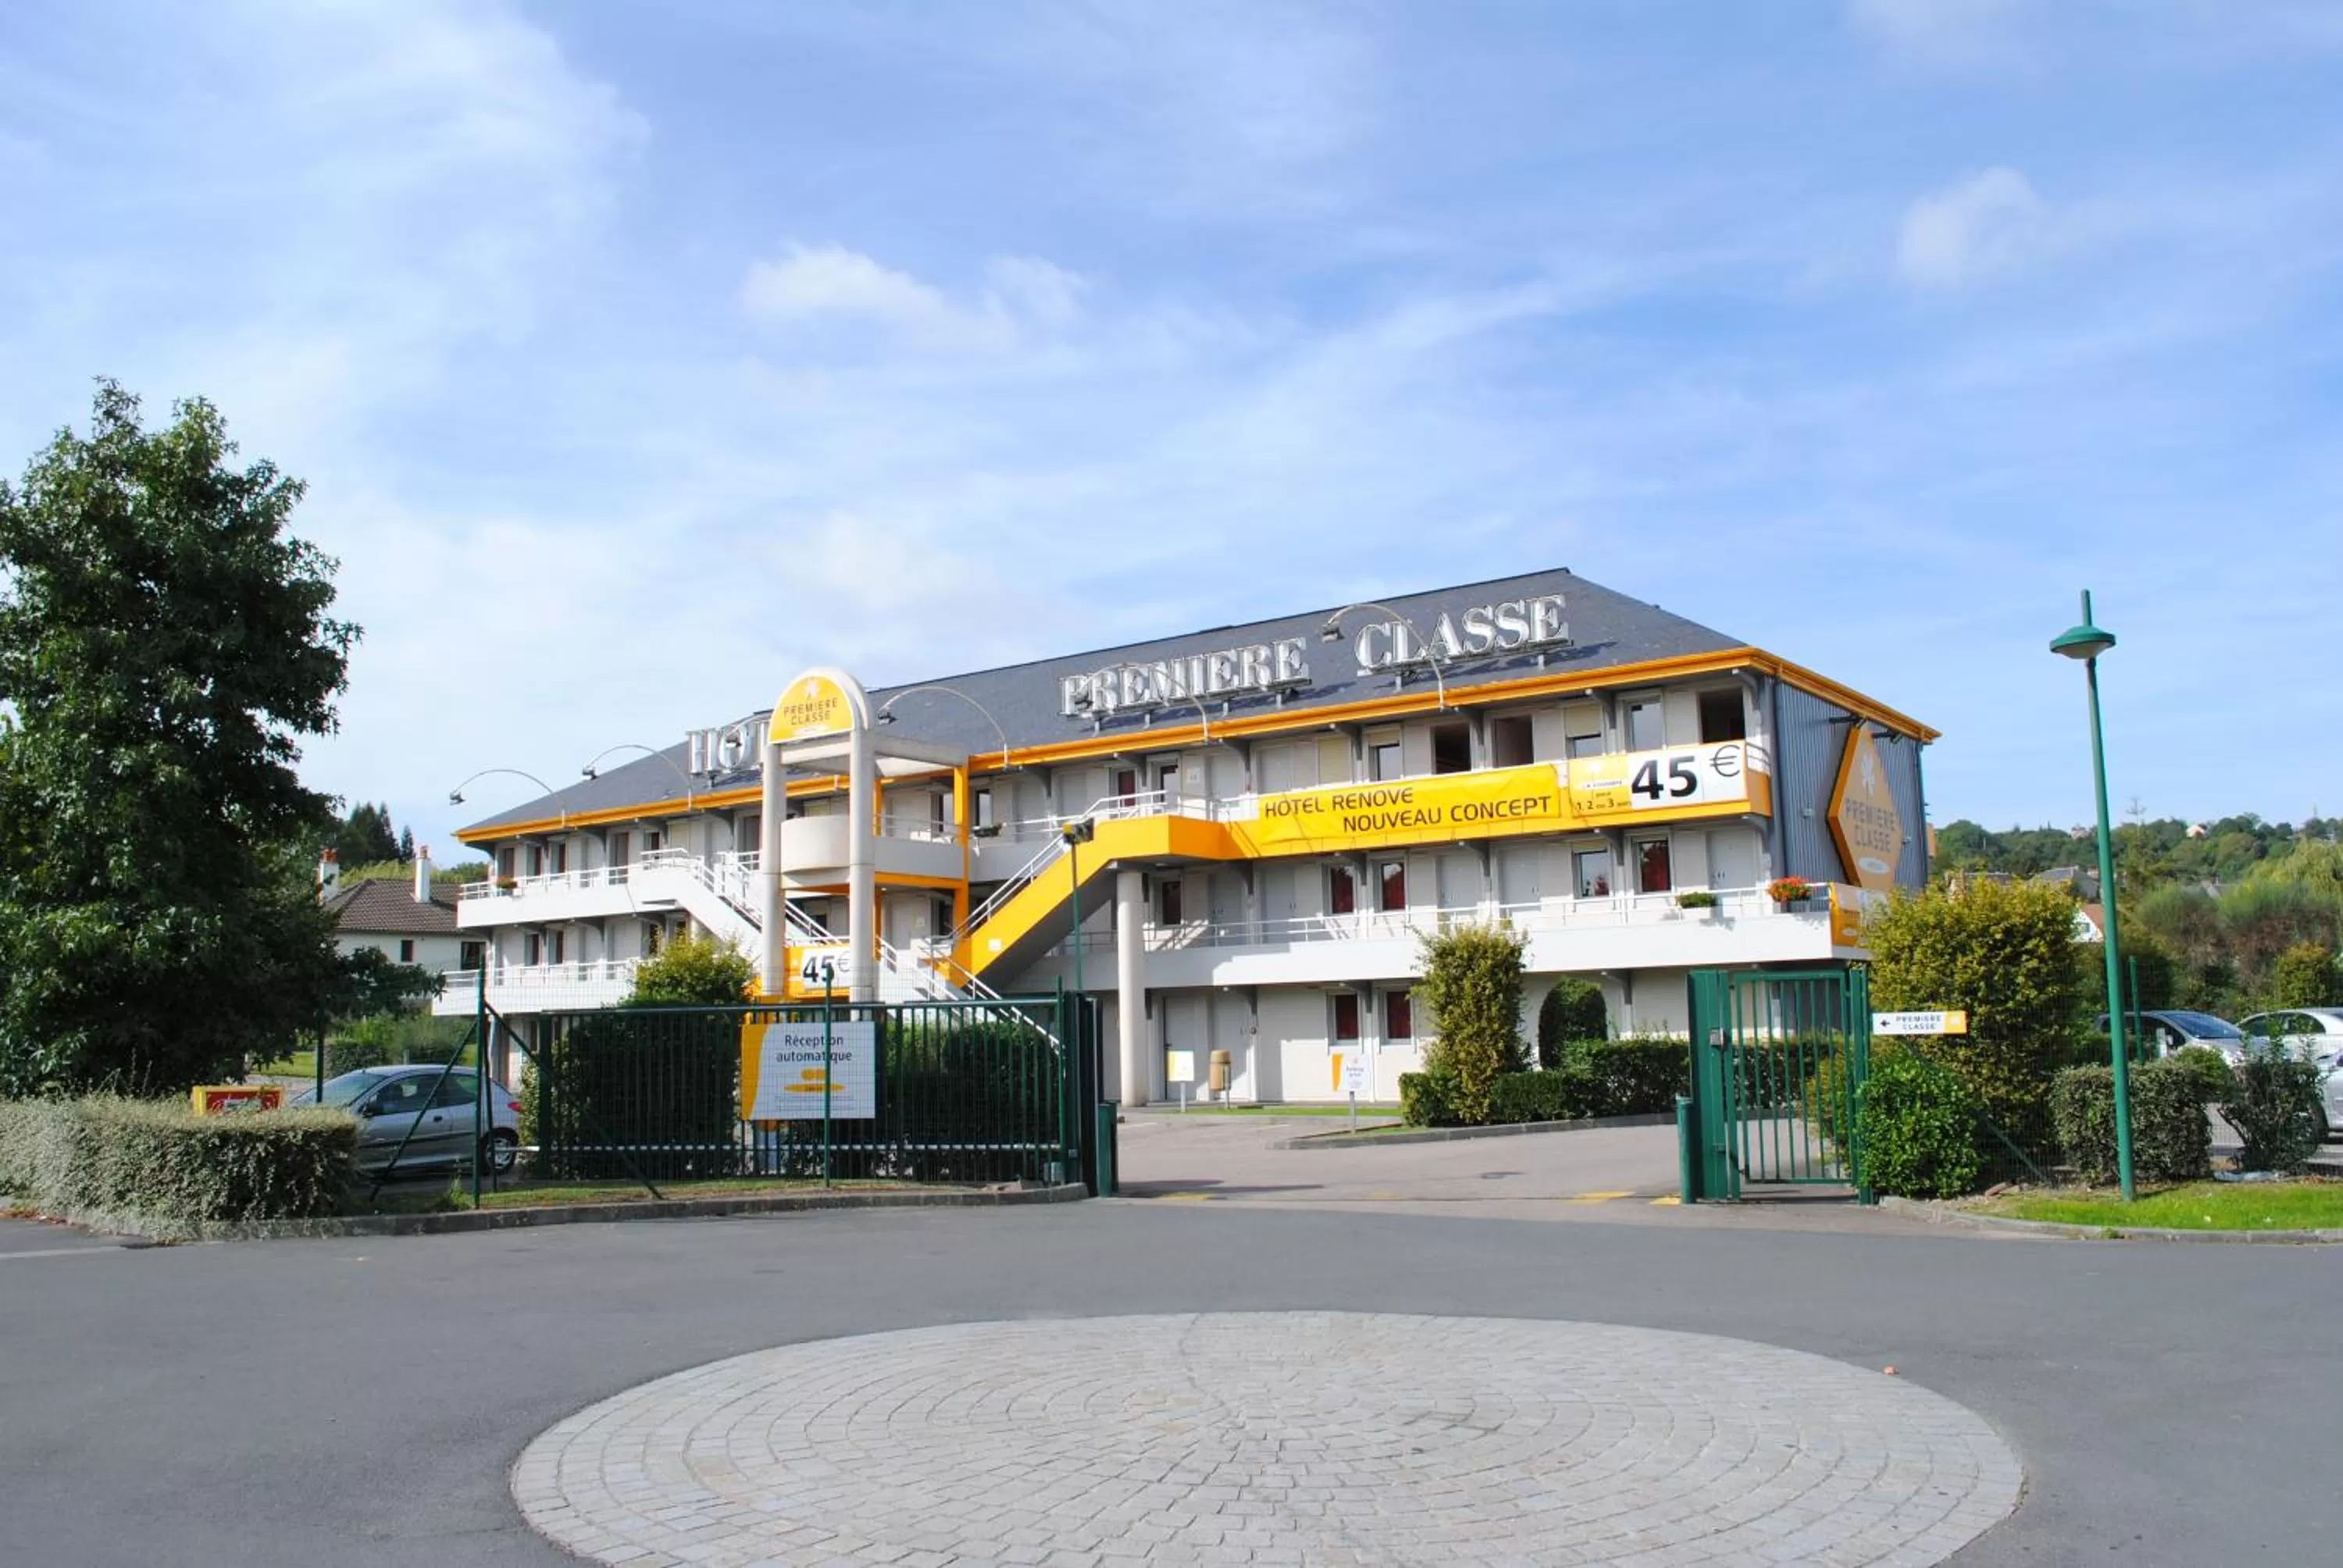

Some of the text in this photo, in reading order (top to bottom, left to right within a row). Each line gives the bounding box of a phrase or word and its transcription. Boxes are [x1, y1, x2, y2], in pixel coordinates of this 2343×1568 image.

[1059, 637, 1311, 715] PREMIERE
[1355, 594, 1569, 669] CLASSE
[790, 710, 831, 725] CLASSE
[1632, 755, 1699, 800] 45
[1343, 795, 1552, 833] NOUVEAU CONCEPT
[784, 1034, 845, 1048] Récepton
[776, 1050, 853, 1064] automatque
